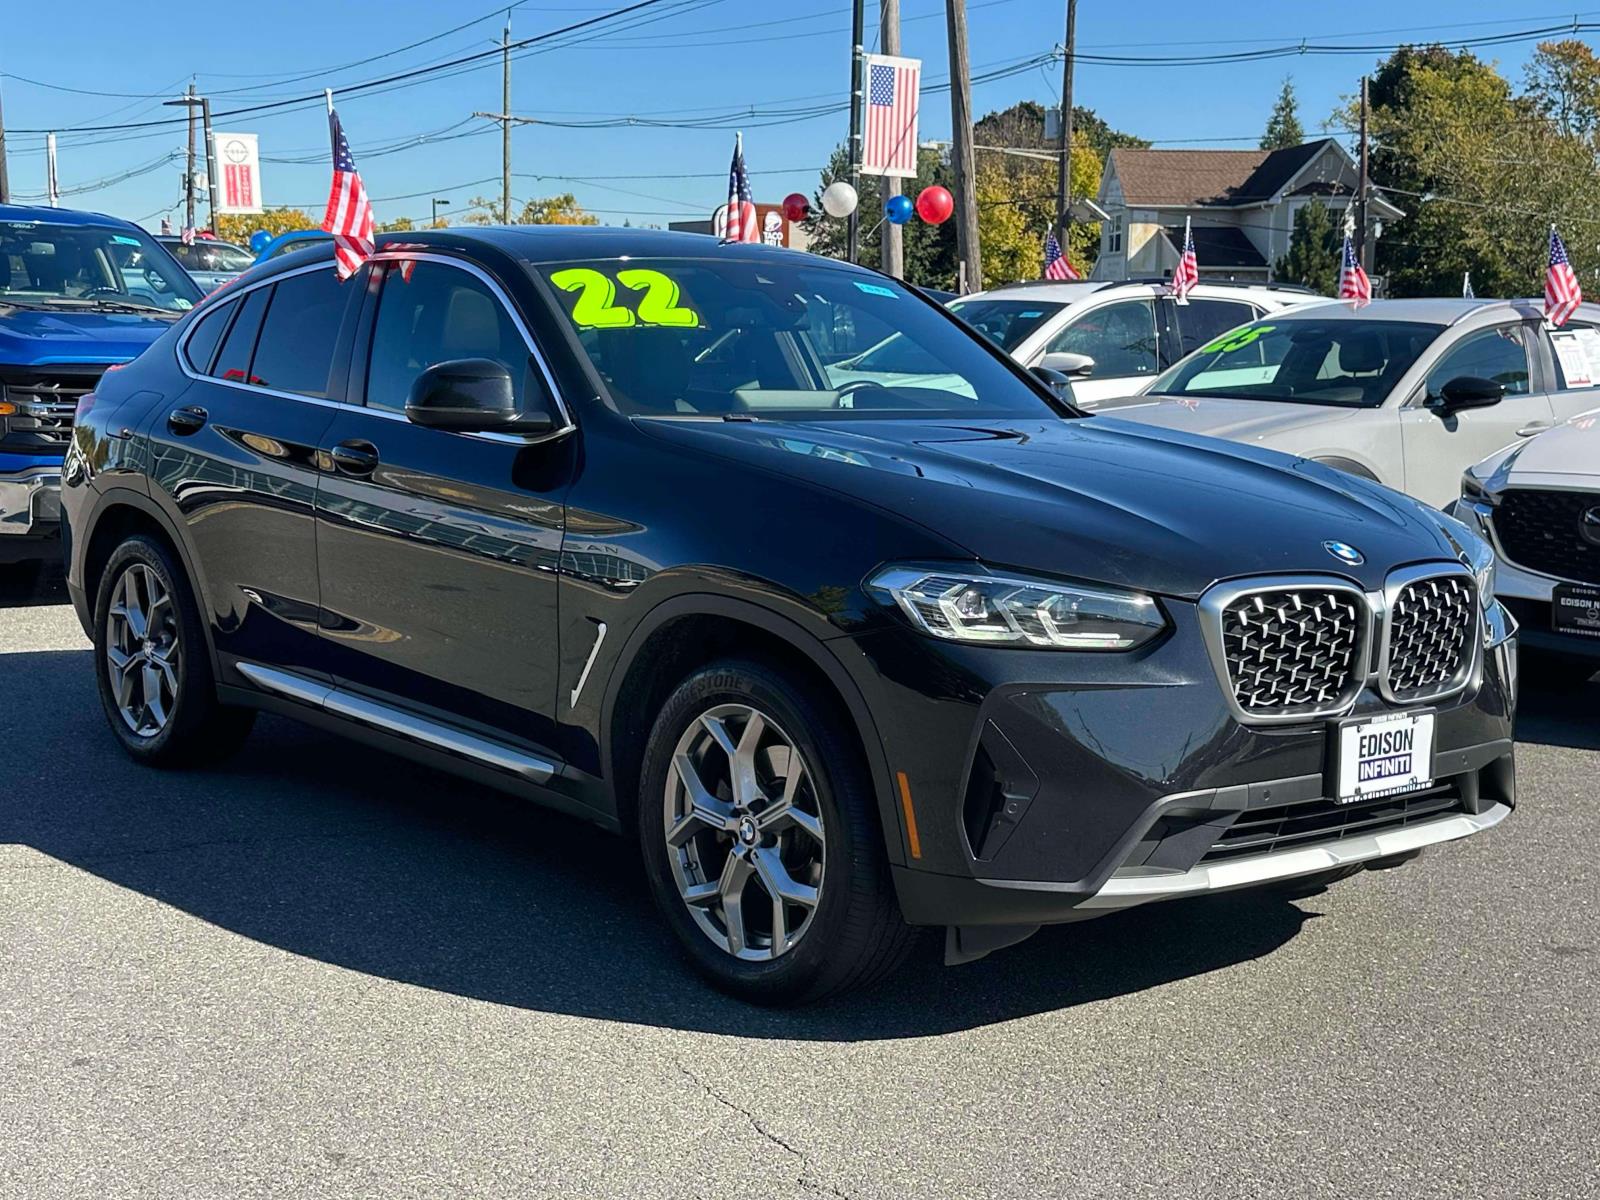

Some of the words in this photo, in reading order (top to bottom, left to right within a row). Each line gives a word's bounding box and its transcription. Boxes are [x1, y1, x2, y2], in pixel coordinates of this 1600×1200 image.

[763, 231, 783, 241] TACO
[550, 268, 699, 329] 22
[1201, 326, 1277, 353] 25
[1560, 598, 1592, 608] EDISON
[1359, 728, 1413, 758] EDISON
[1361, 757, 1410, 780] INFINITI
